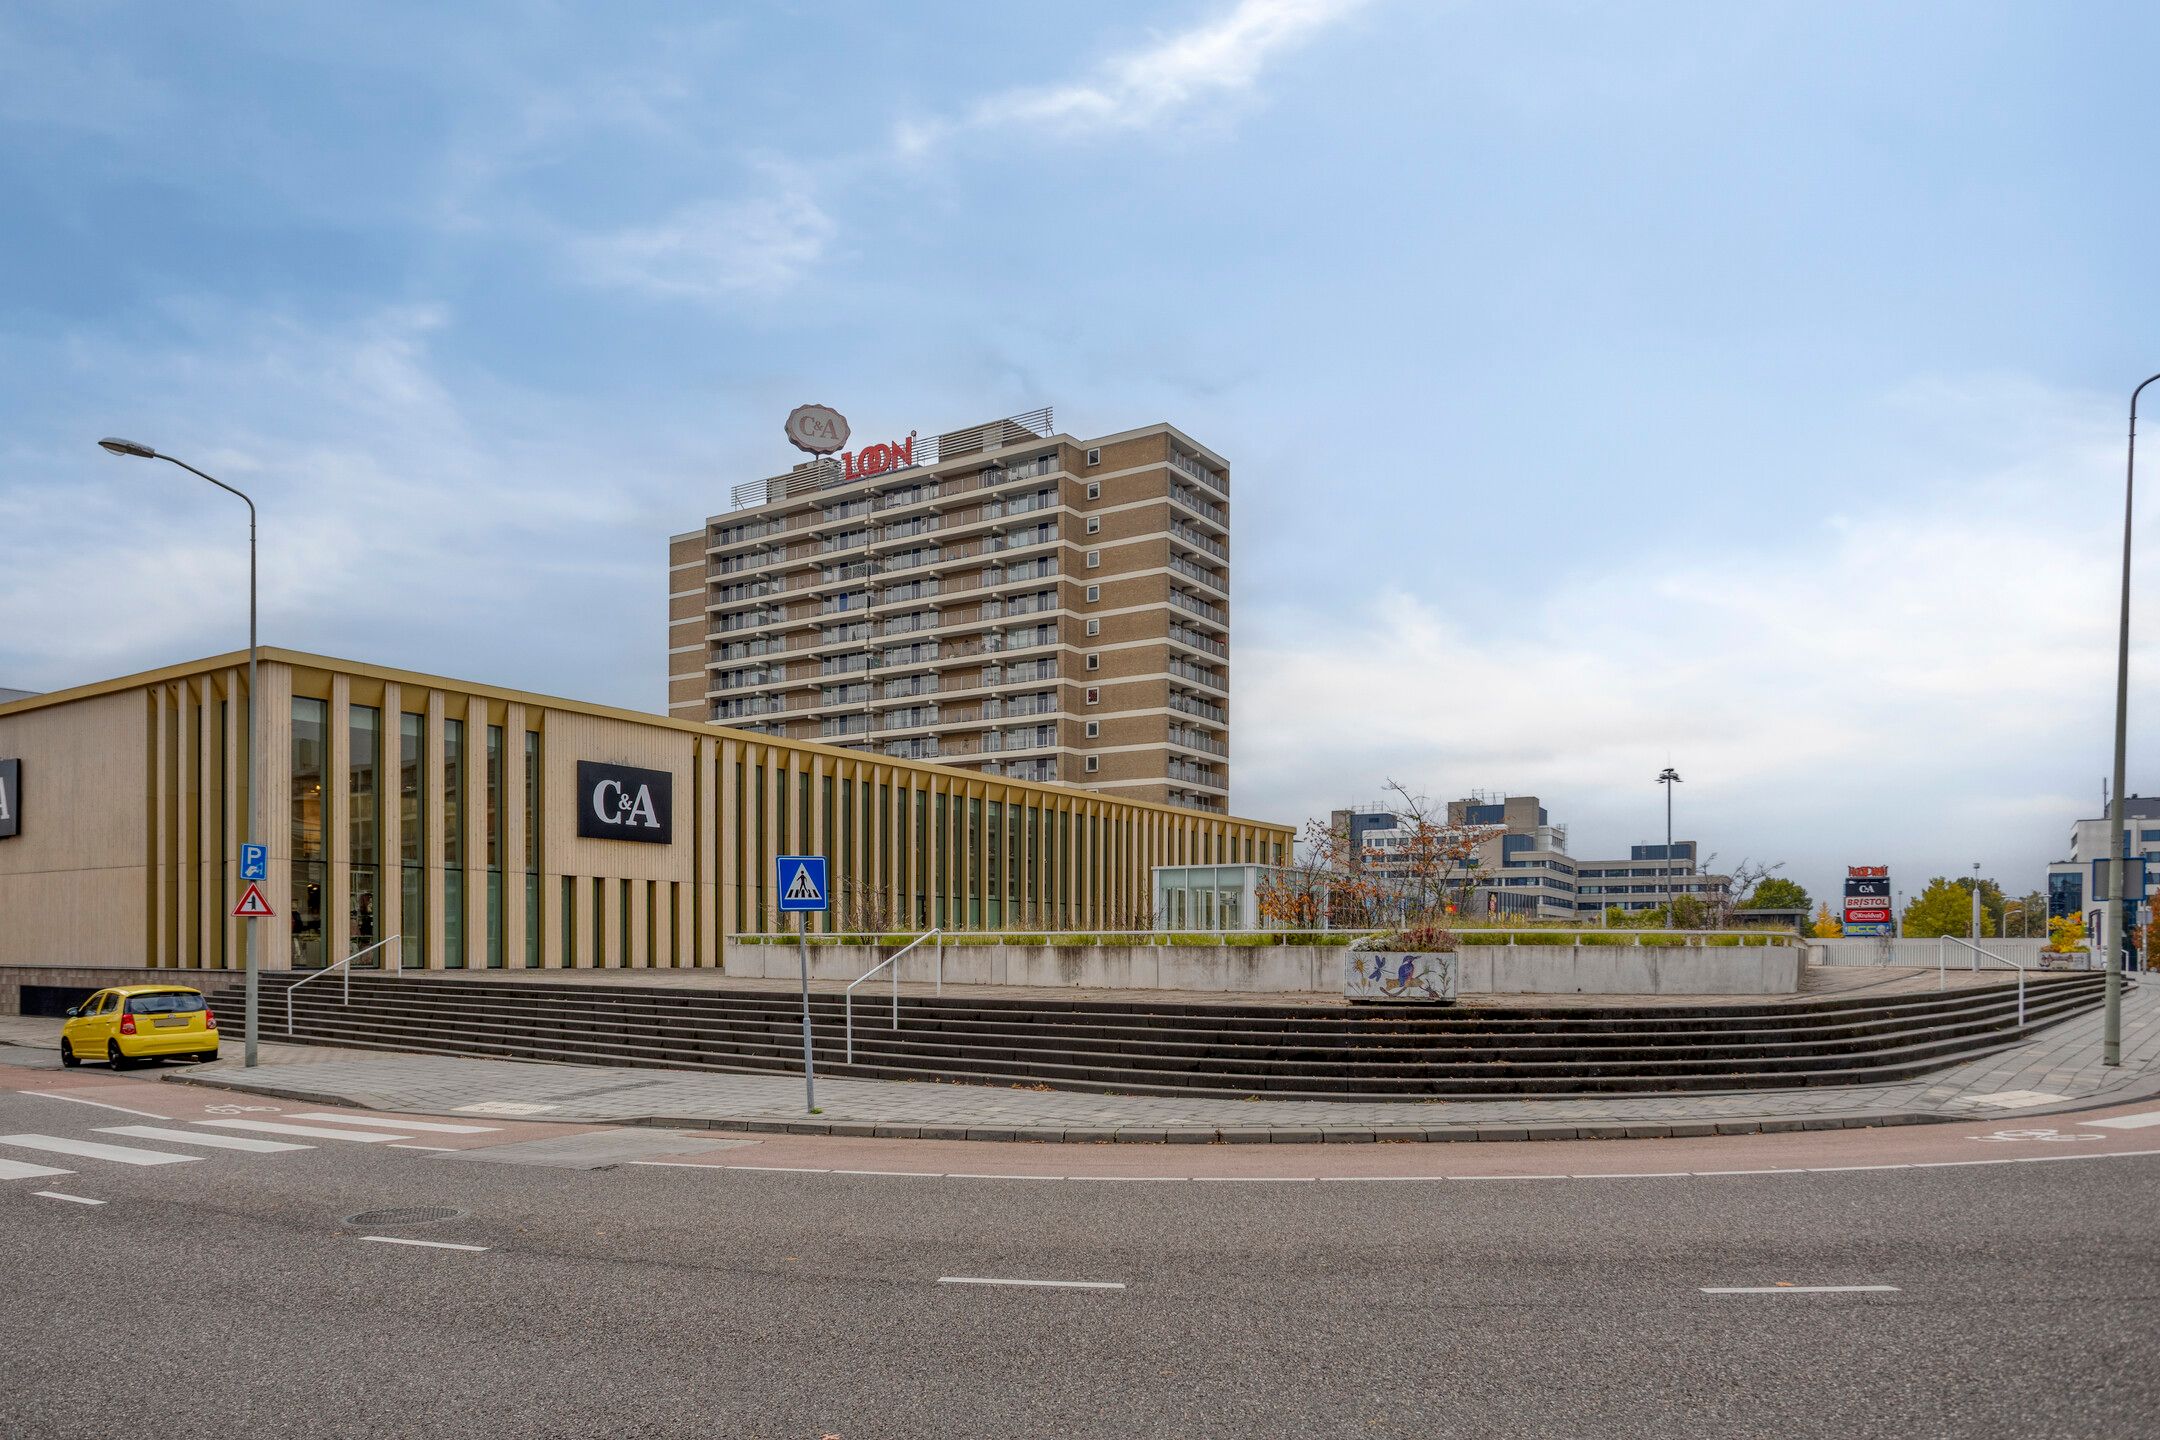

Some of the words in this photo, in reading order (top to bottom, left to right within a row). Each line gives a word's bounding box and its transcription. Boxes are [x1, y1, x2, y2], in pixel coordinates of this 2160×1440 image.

[799, 416, 839, 440] C&A
[593, 779, 660, 828] C&A
[247, 846, 262, 865] P
